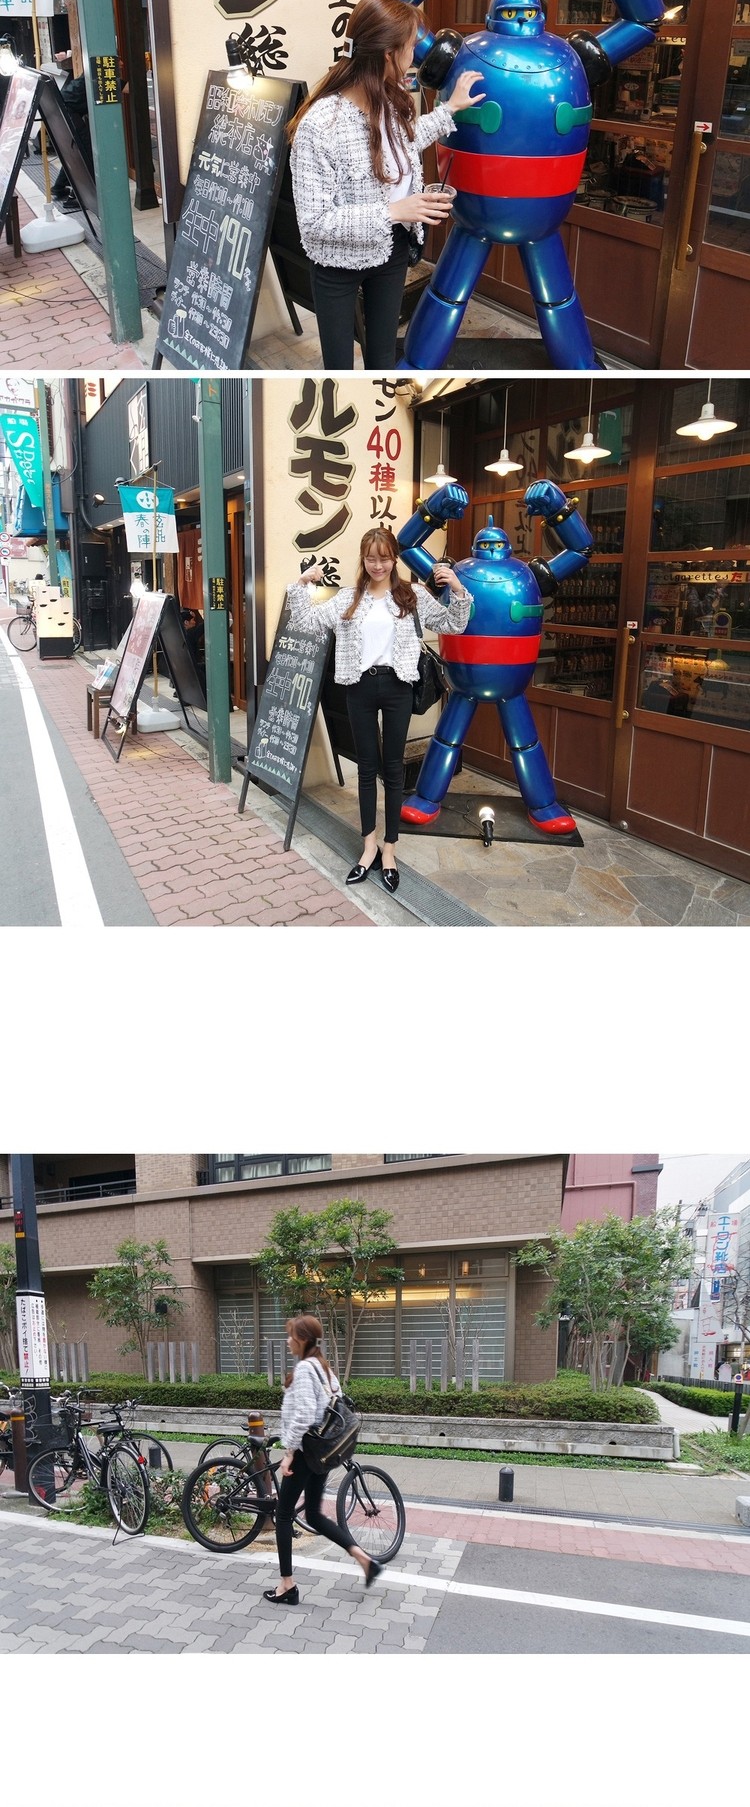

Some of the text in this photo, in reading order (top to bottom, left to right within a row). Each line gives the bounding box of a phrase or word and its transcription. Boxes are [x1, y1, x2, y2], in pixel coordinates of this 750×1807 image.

[102, 55, 119, 103] 駐車禁止
[215, 214, 252, 281] 190
[663, 571, 729, 583] cigarettes
